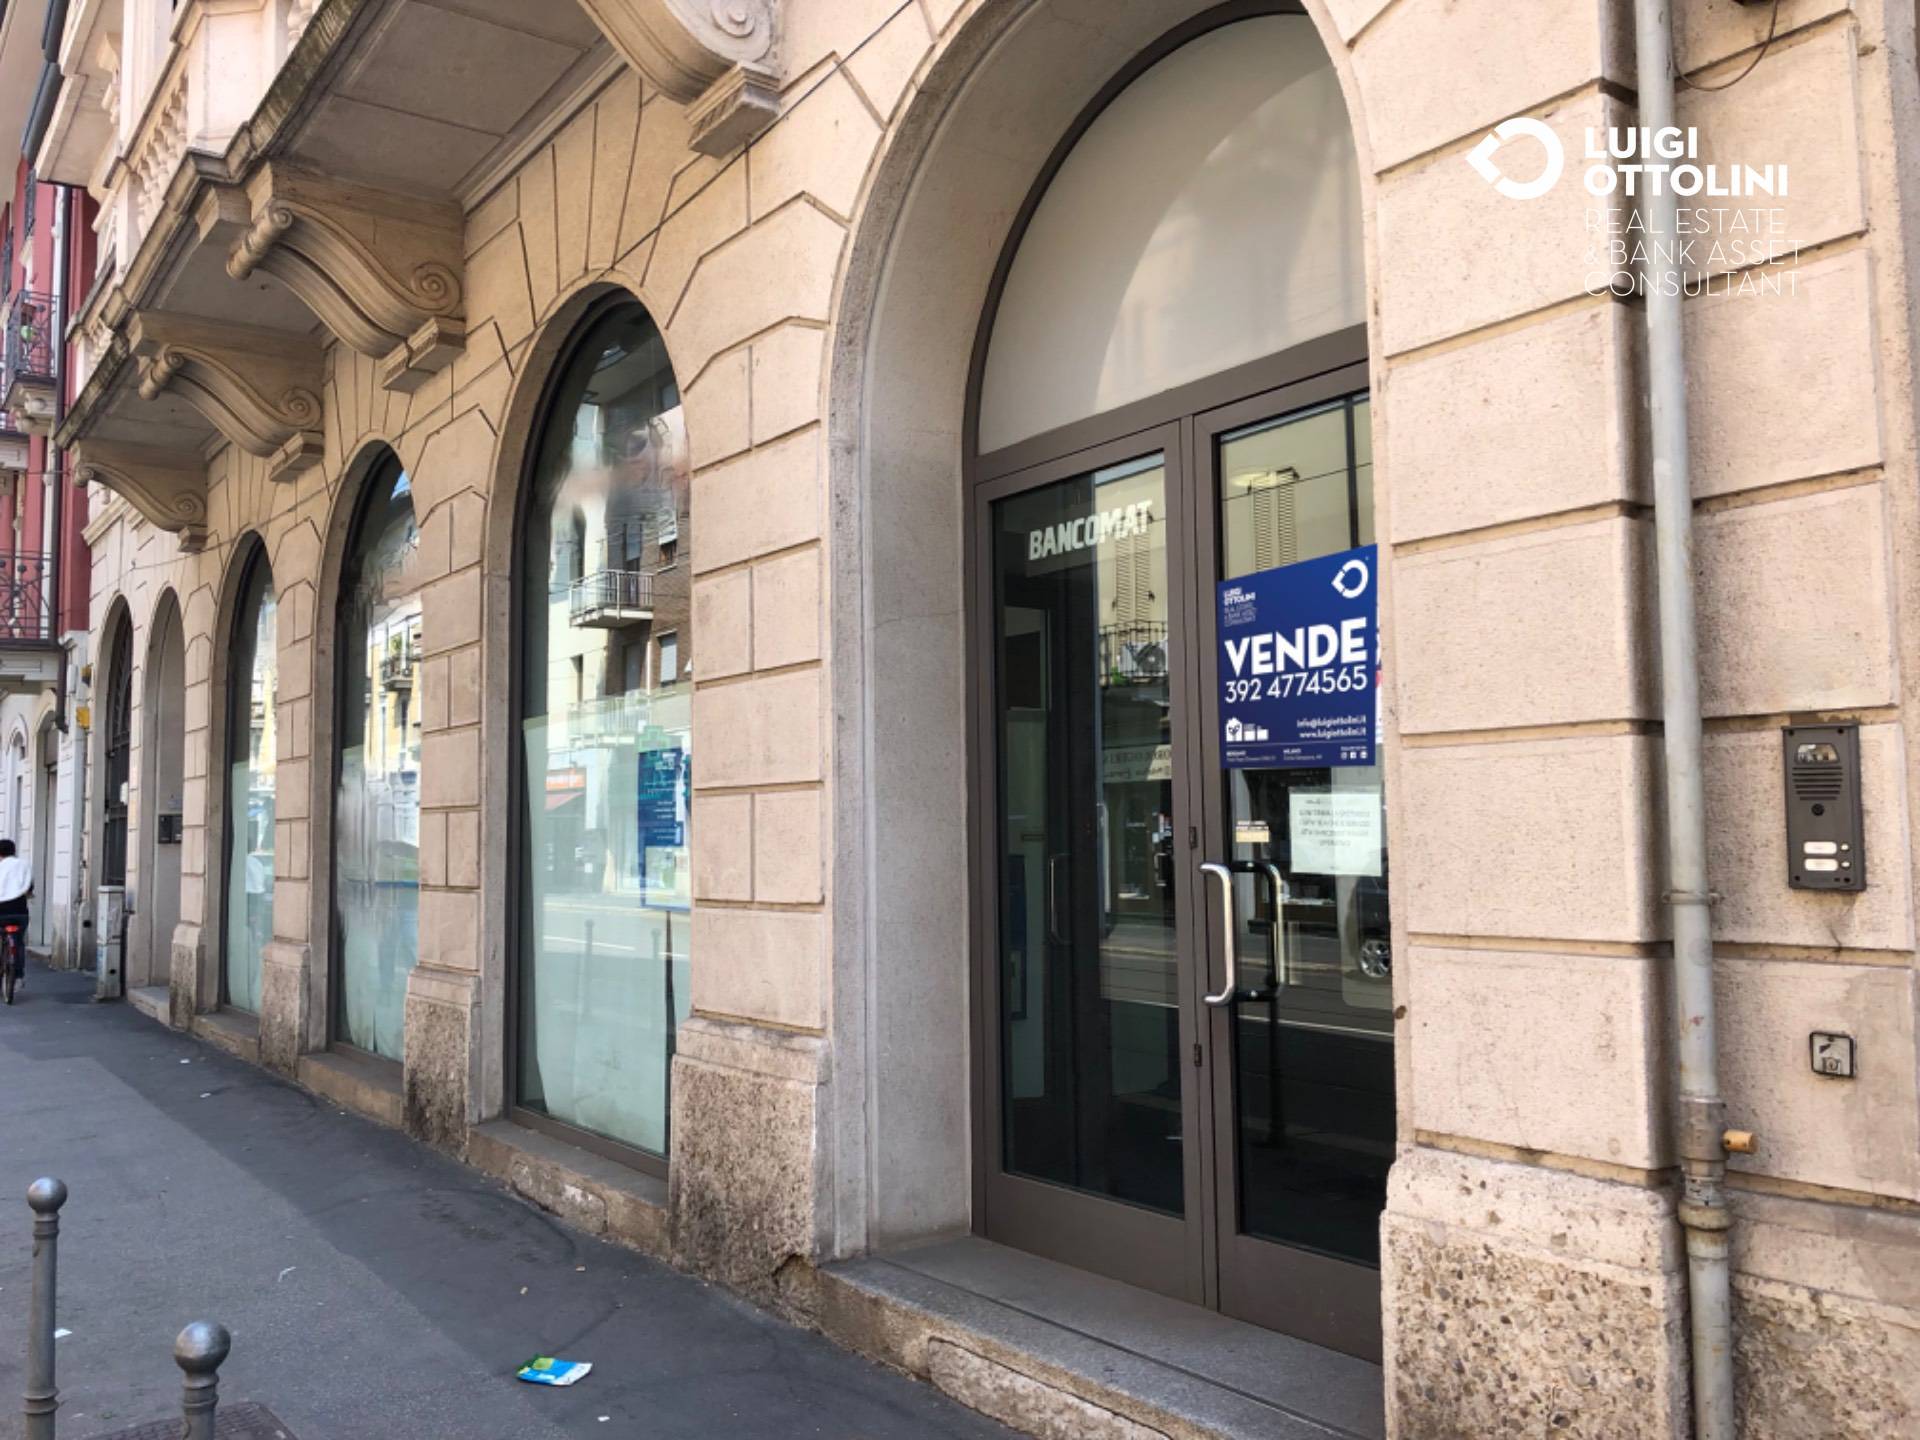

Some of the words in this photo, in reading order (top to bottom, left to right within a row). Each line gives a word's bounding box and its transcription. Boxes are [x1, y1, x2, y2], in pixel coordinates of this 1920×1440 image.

[1028, 500, 1153, 560] BANCOMAT
[1224, 616, 1368, 678] VENDE
[1224, 678, 1262, 703] 392
[1266, 665, 1368, 699] 4774565
